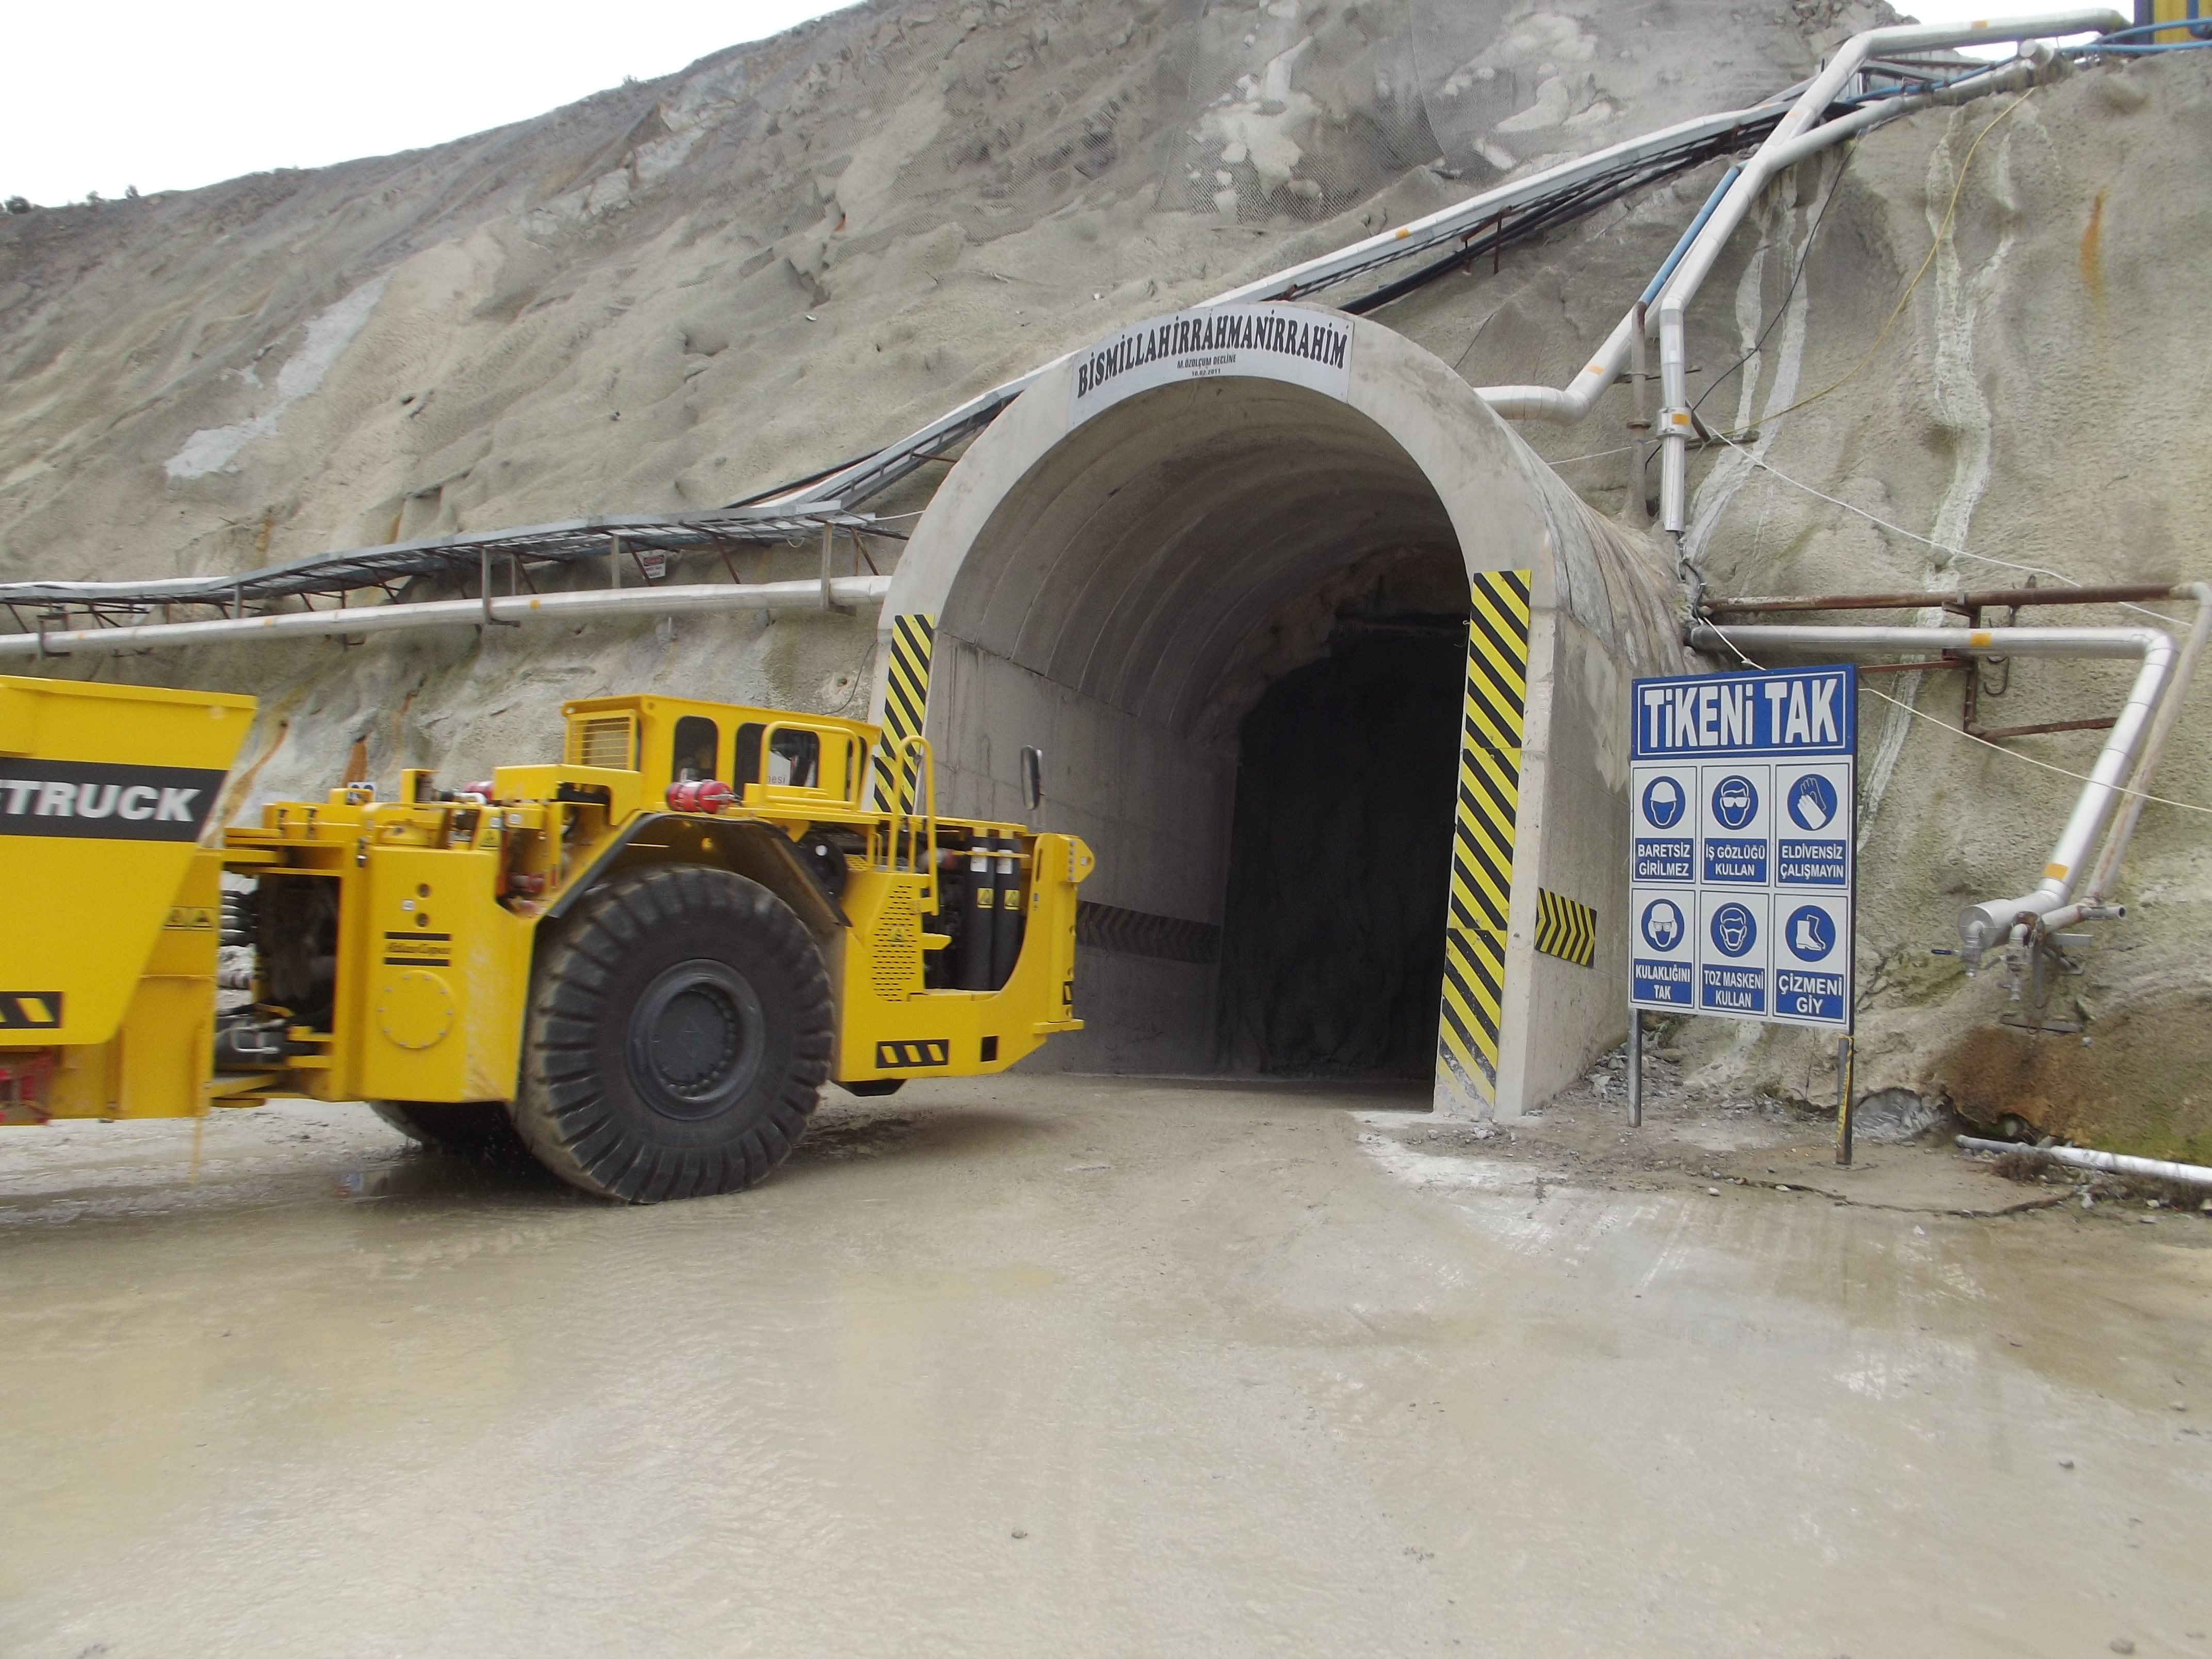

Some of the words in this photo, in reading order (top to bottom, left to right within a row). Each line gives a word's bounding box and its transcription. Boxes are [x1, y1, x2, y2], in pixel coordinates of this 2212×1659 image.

[1765, 679, 1837, 744] TAK
[0, 779, 202, 822] TRUCK
[1637, 841, 1690, 858] BARETSİZ
[1705, 843, 1715, 861] İŞ
[1717, 844, 1765, 859] GÖZLÜĞÜ
[1782, 843, 1843, 859] ELDİVENSİZ
[1638, 860, 1689, 876] GİRİLMEZ
[1715, 864, 1754, 876] KULLAN
[1780, 864, 1844, 880] ÇALIŞMAYIN
[1635, 964, 1690, 983] KULAKLIĞINI
[1703, 970, 1721, 985] TOZ
[1722, 971, 1764, 990] MASKENİ
[1654, 984, 1671, 1000] TAK
[1778, 973, 1843, 997] ÇİZMENİ
[1715, 990, 1752, 1008] KULLAN
[1796, 995, 1823, 1014] GİY
